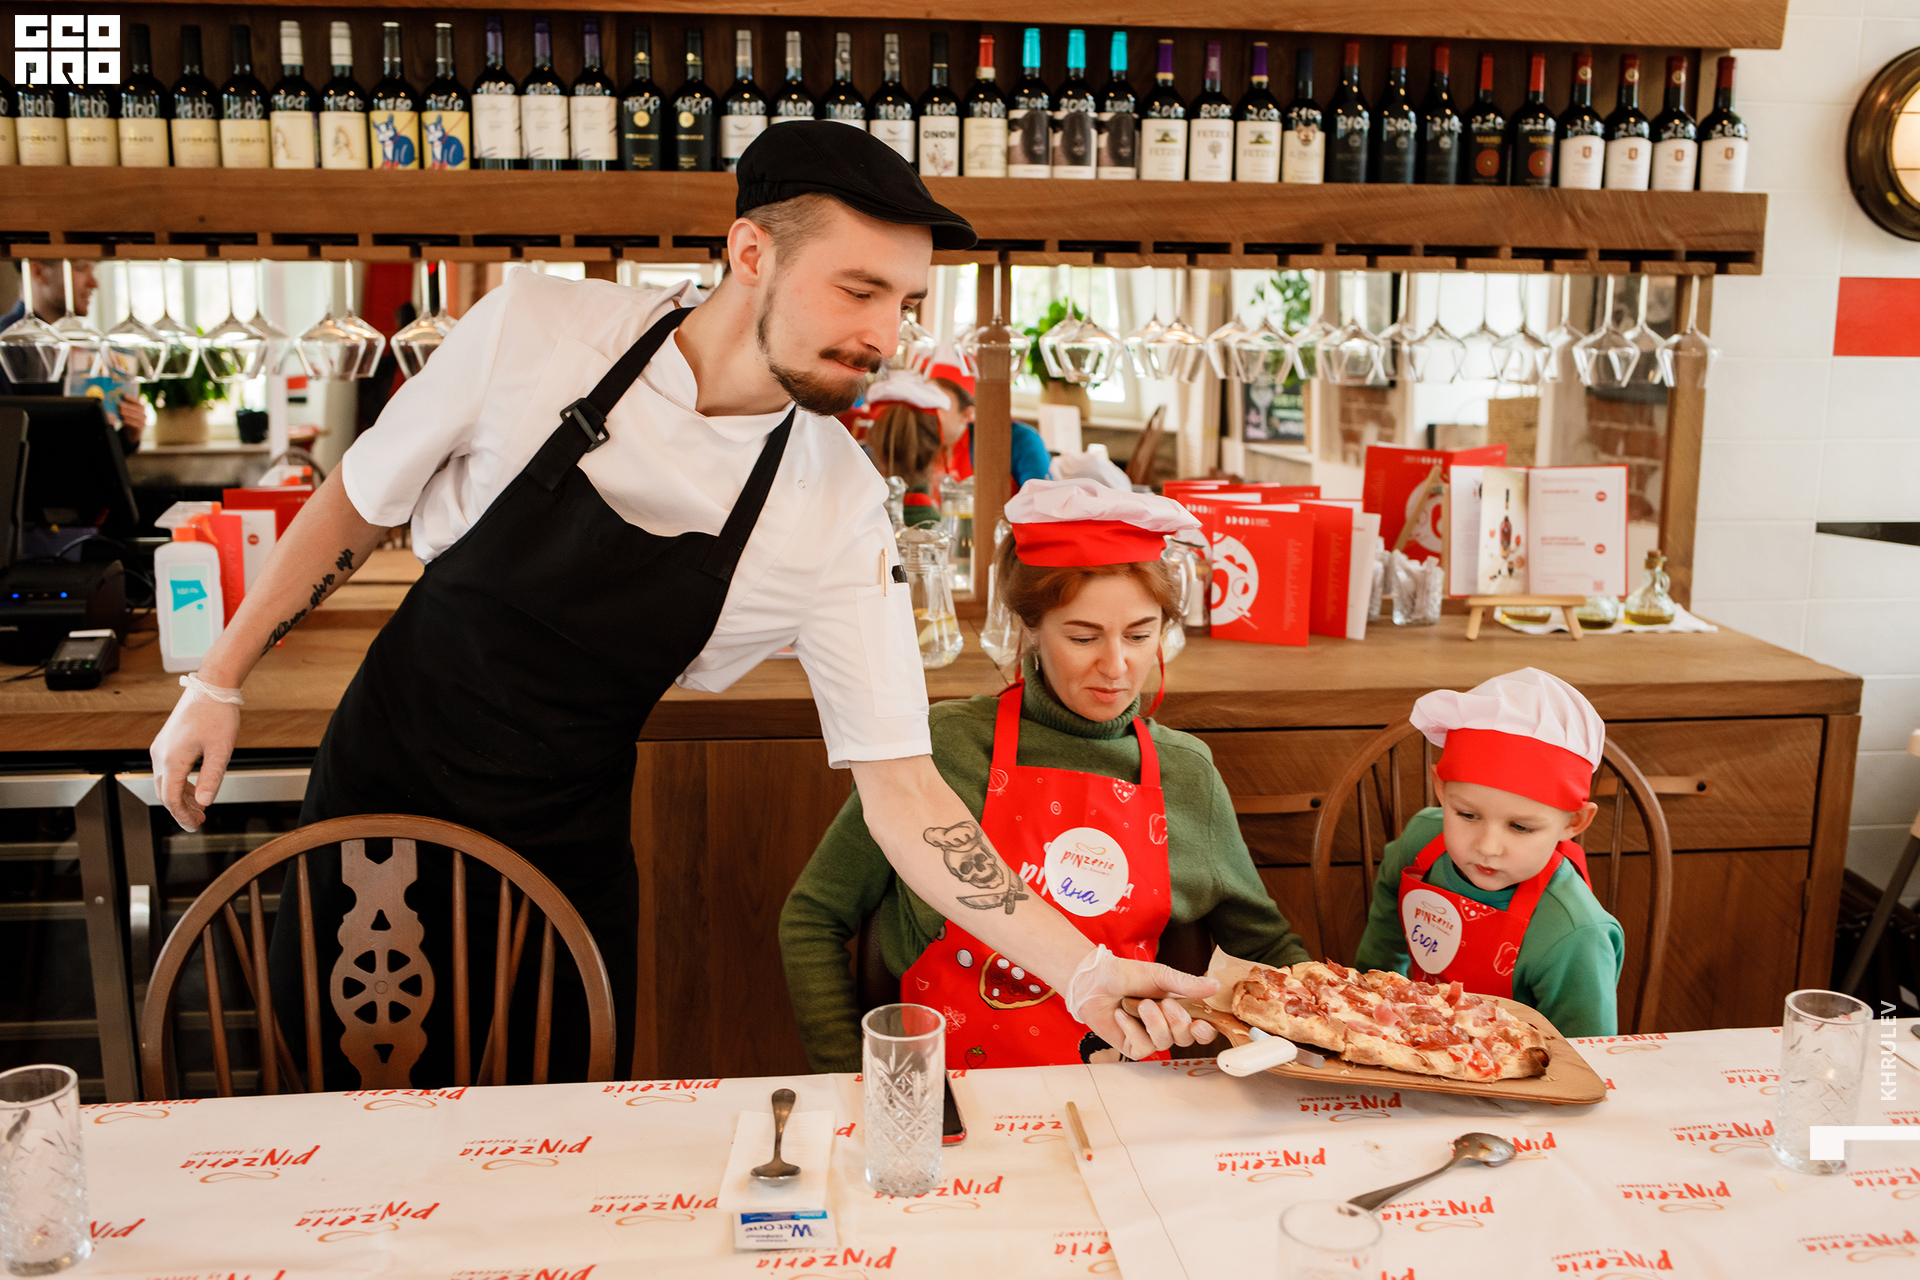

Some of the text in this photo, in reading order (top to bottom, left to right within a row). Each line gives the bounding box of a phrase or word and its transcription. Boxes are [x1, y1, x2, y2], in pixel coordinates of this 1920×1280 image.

[1057, 877, 1099, 904] Яна
[1300, 1092, 1402, 1117] piNzeria
[1676, 1119, 1775, 1146] piNzeria
[180, 1145, 321, 1174] piNzeria
[459, 1136, 592, 1161] piNzeria
[1217, 1147, 1326, 1176] piNzeria
[1622, 1180, 1731, 1205] piNzeria
[294, 1201, 440, 1232] piNzeria
[1381, 1196, 1494, 1225] piNzeria
[756, 1246, 897, 1275] piNzeria
[1556, 1249, 1673, 1277] piNzeria
